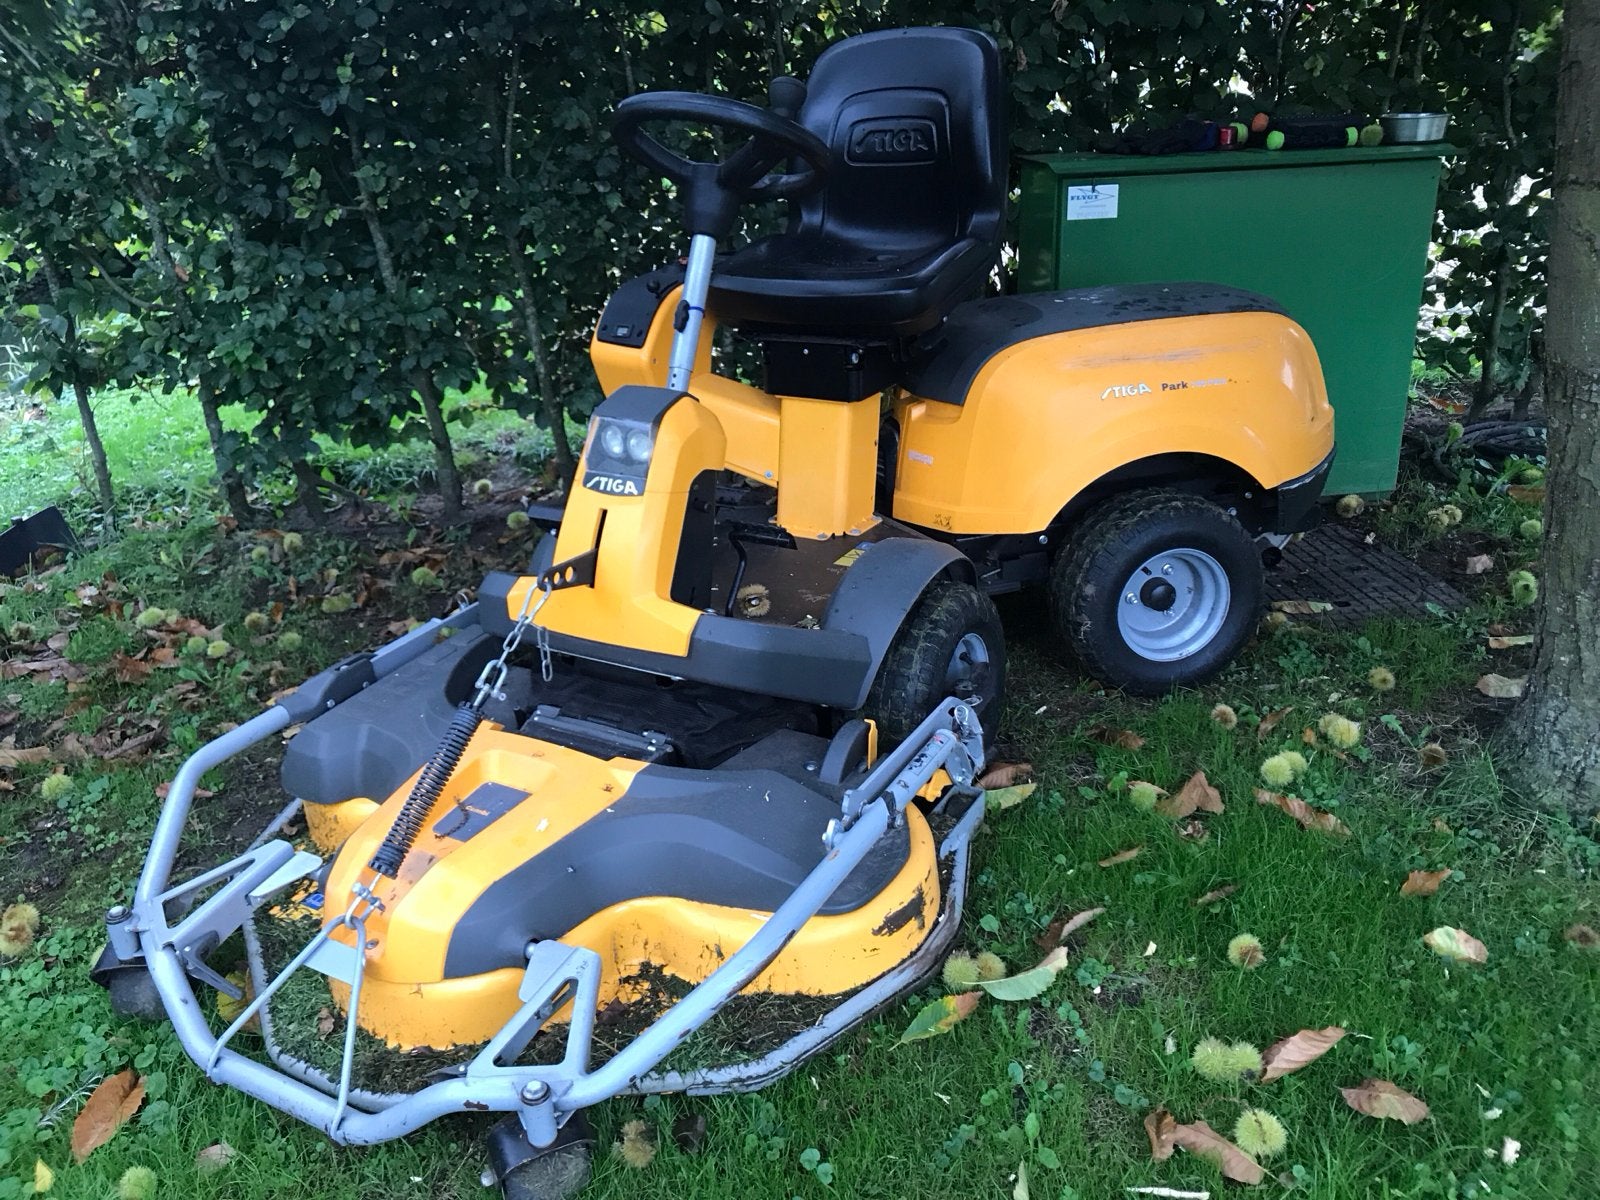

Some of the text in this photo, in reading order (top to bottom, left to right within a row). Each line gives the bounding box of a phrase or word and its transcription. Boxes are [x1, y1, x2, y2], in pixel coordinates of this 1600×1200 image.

[1101, 382, 1152, 400] STIGA
[1161, 381, 1189, 391] Park
[586, 476, 638, 495] STIGA
